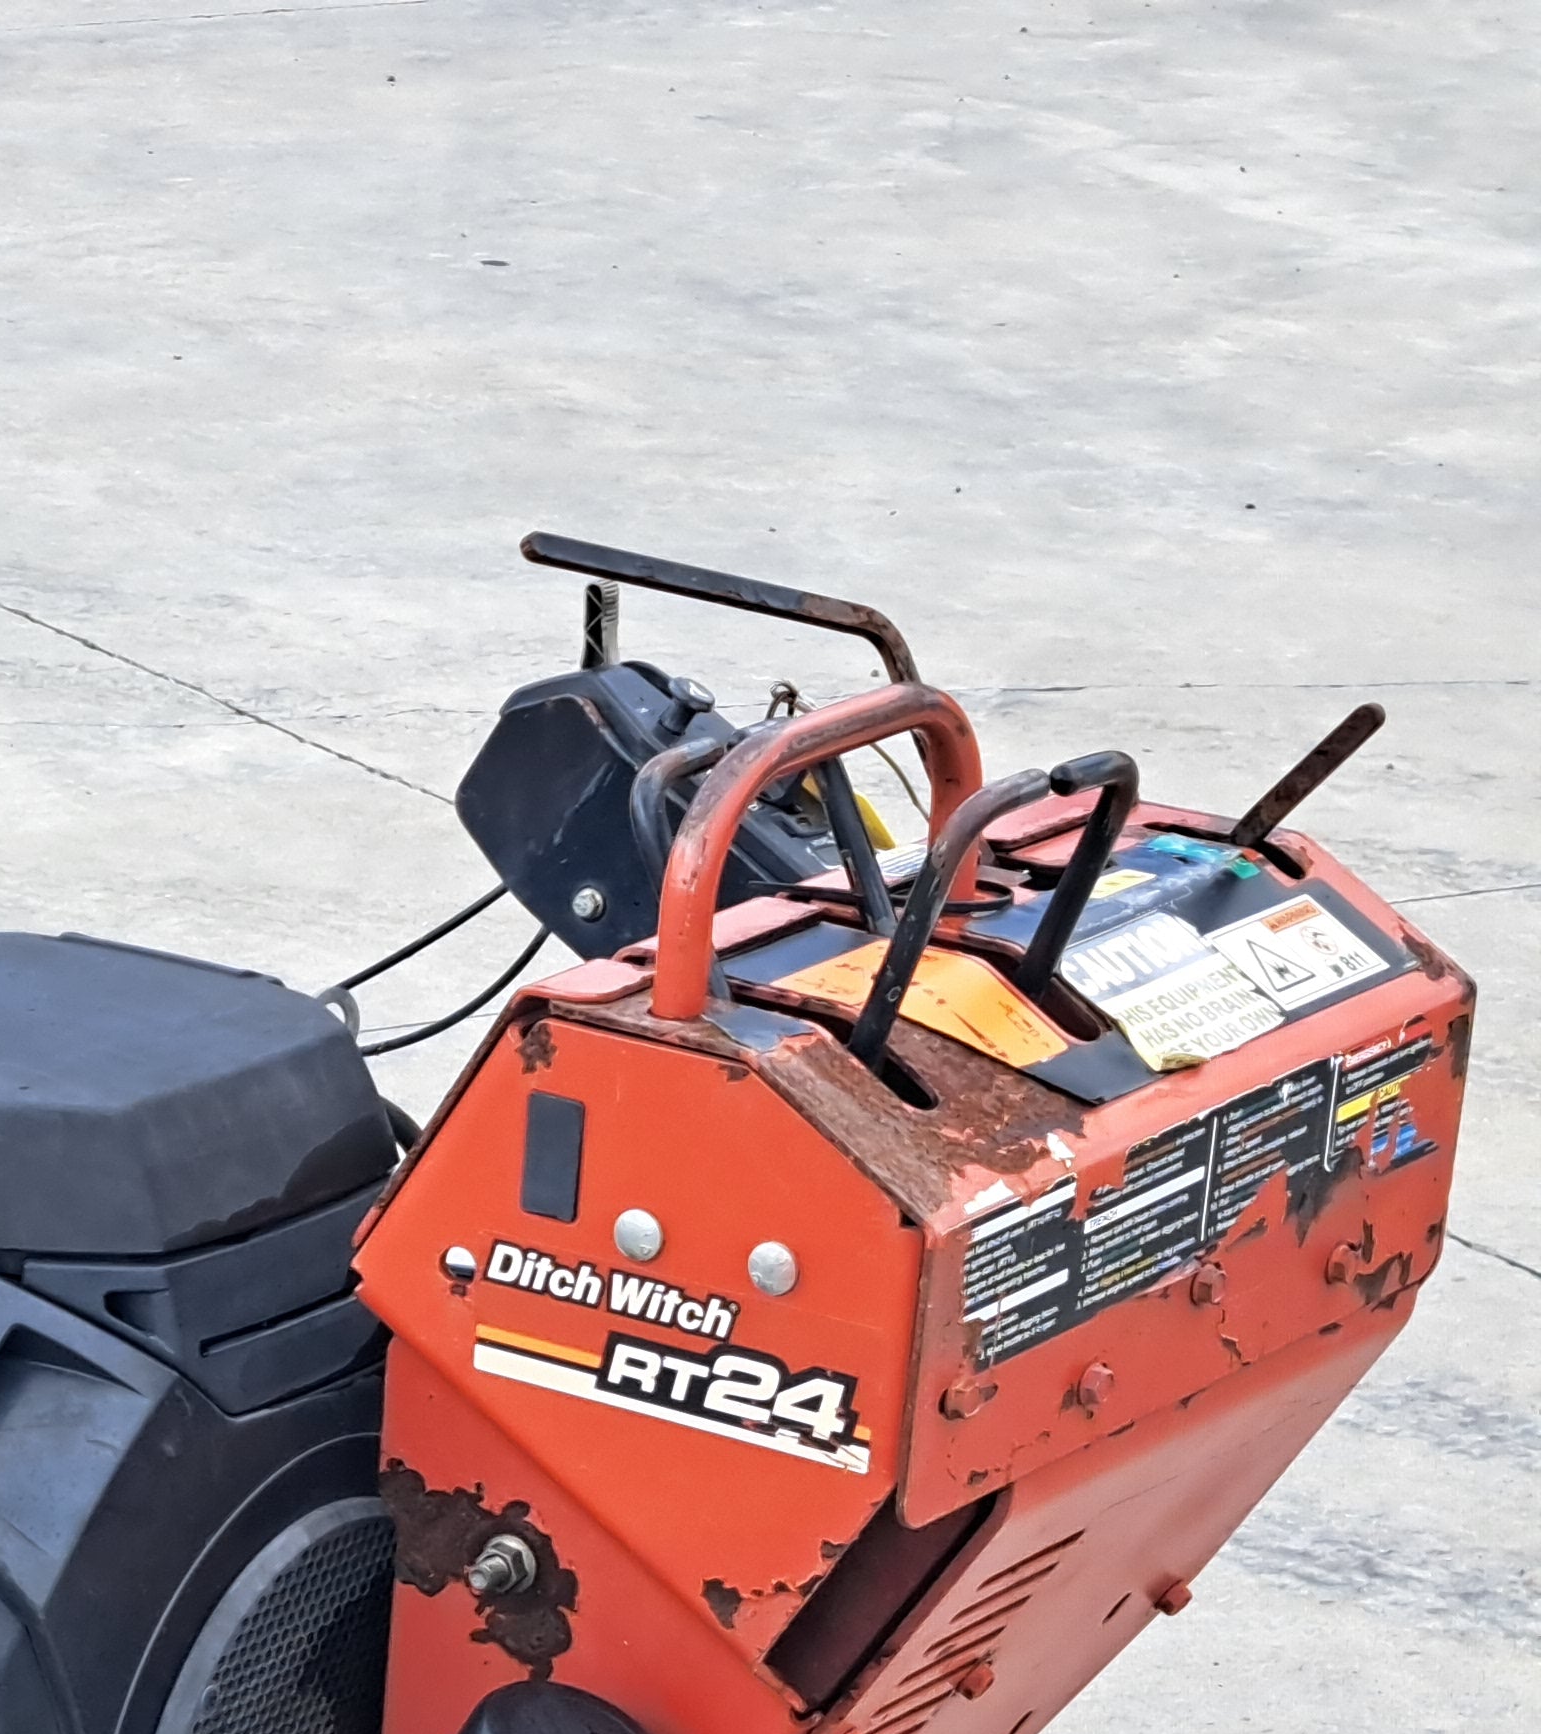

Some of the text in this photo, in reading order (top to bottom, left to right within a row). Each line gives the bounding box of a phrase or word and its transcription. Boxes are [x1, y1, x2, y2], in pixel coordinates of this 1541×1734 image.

[1061, 917, 1205, 997] CAUTION
[1116, 1003, 1154, 1027] HIS
[1138, 1022, 1180, 1049] HAS
[1172, 1011, 1205, 1034] NO
[1190, 1021, 1246, 1053] YOUR
[1238, 1004, 1281, 1032] OWN
[486, 1242, 736, 1339] Ditch Witch
[607, 1343, 847, 1440] RT24
